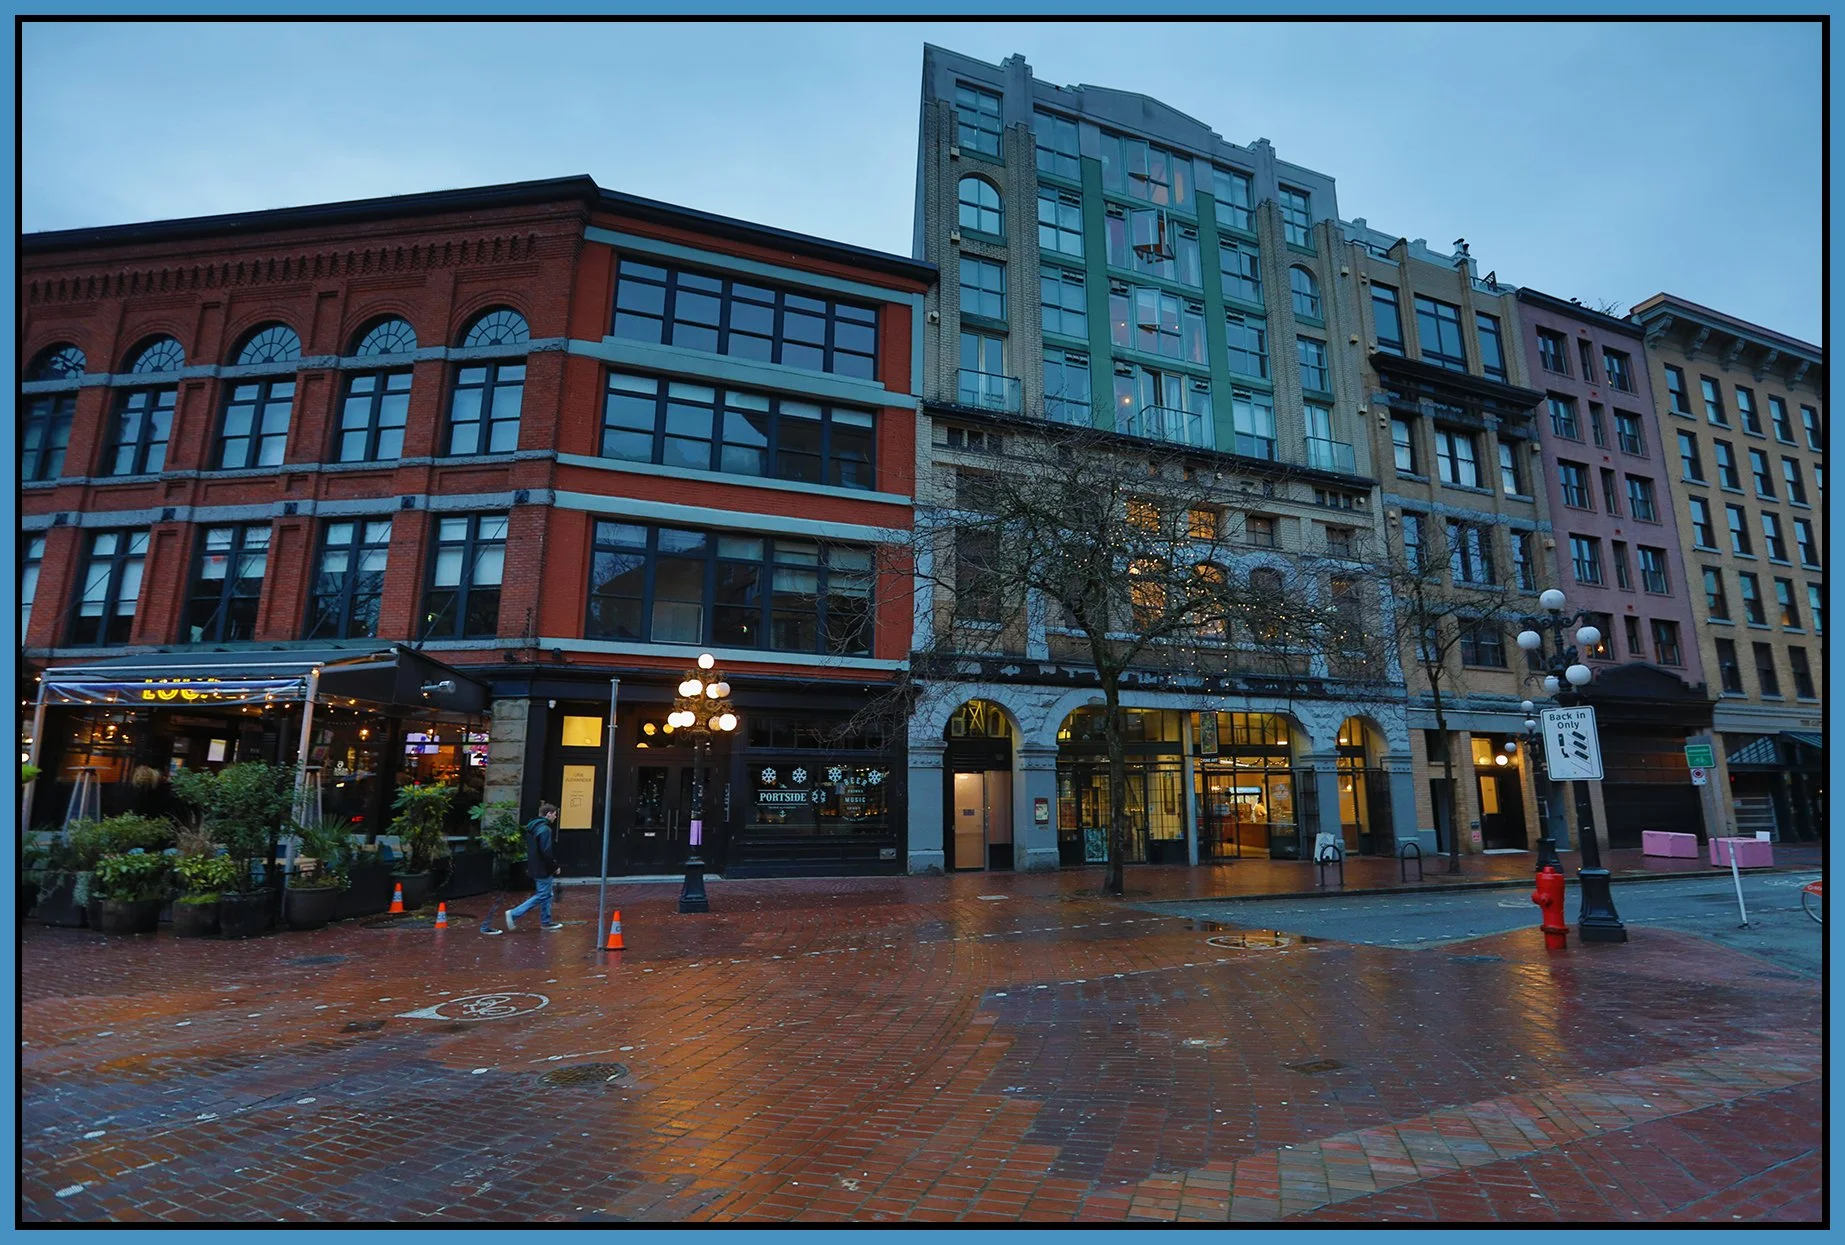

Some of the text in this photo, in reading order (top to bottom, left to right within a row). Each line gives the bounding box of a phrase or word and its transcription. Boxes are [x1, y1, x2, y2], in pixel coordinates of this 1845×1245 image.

[1549, 711, 1586, 721] Back in
[1557, 721, 1580, 730] Only
[843, 777, 868, 787] BEER
[759, 792, 807, 802] PORTSIDE
